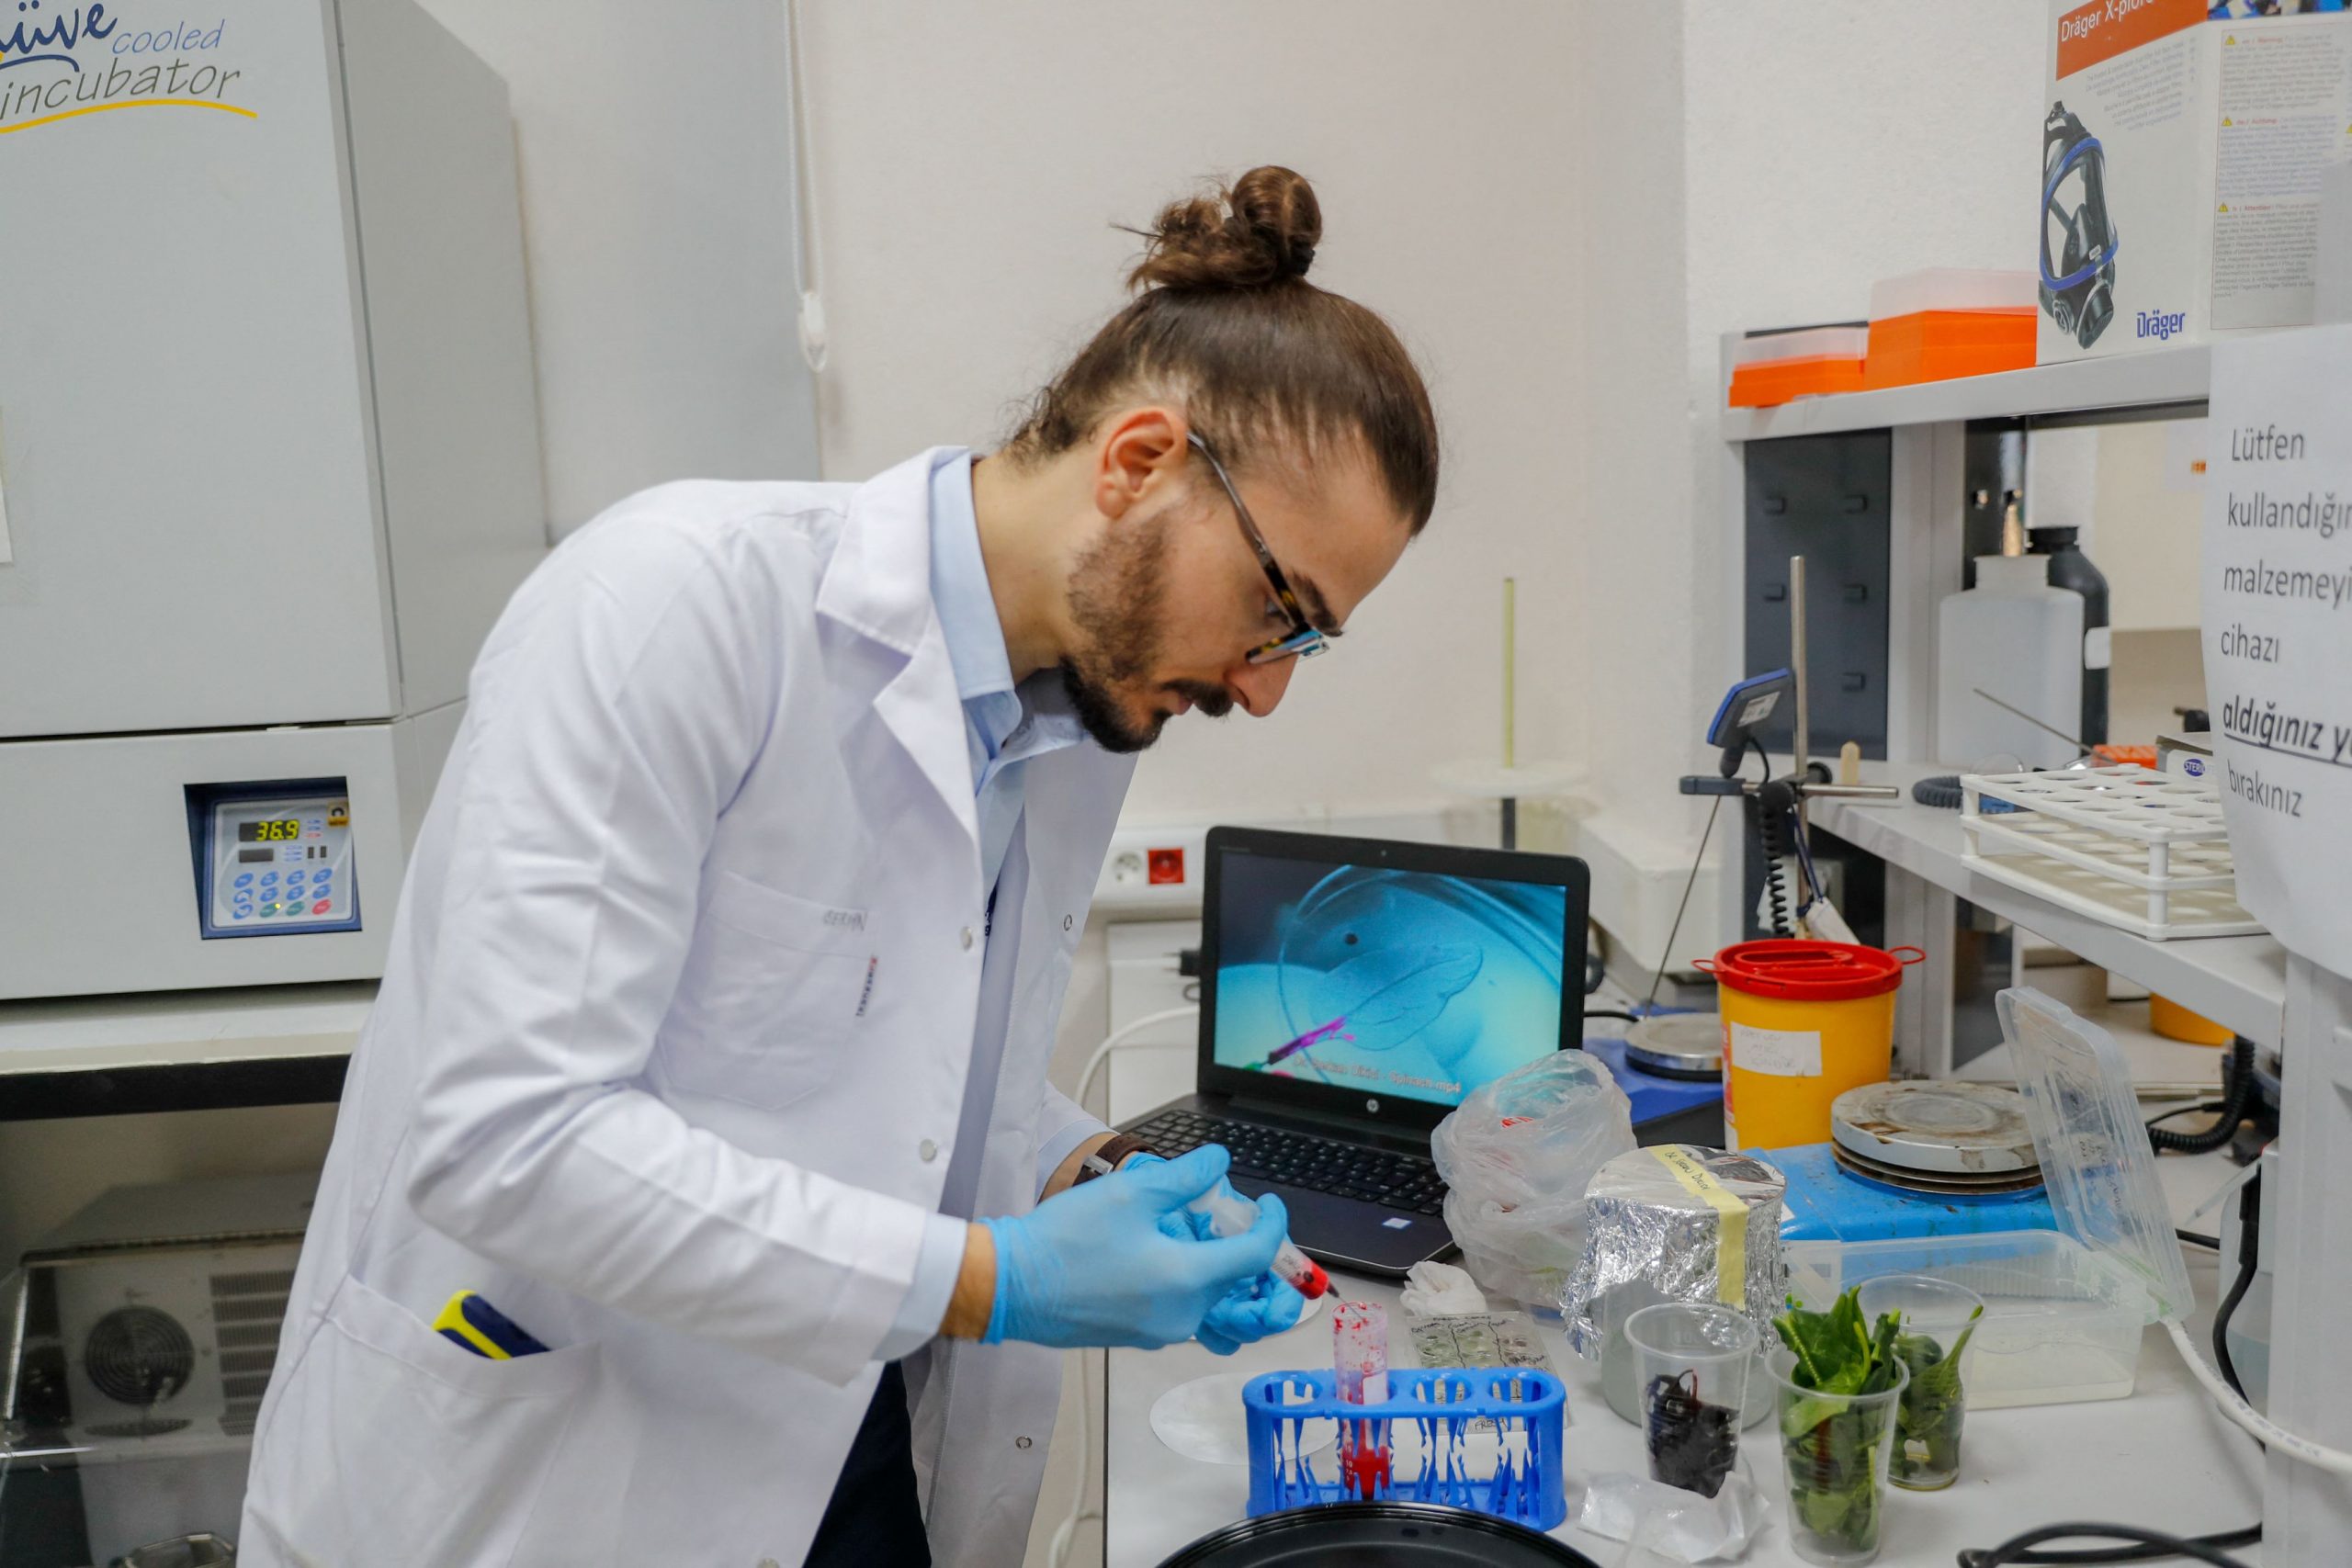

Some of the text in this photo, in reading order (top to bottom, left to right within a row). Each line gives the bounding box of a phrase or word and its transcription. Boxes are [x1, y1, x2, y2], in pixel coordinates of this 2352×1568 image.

[0, 0, 225, 54] üve cooled
[2061, 10, 2102, 42] Dräger
[0, 57, 241, 119] incubator
[2136, 309, 2186, 341] Dräger
[2231, 424, 2305, 461] Lütfen
[2220, 623, 2279, 663] cihazı
[2222, 694, 2352, 764] aldığınız y
[2227, 759, 2302, 818] bırakınız
